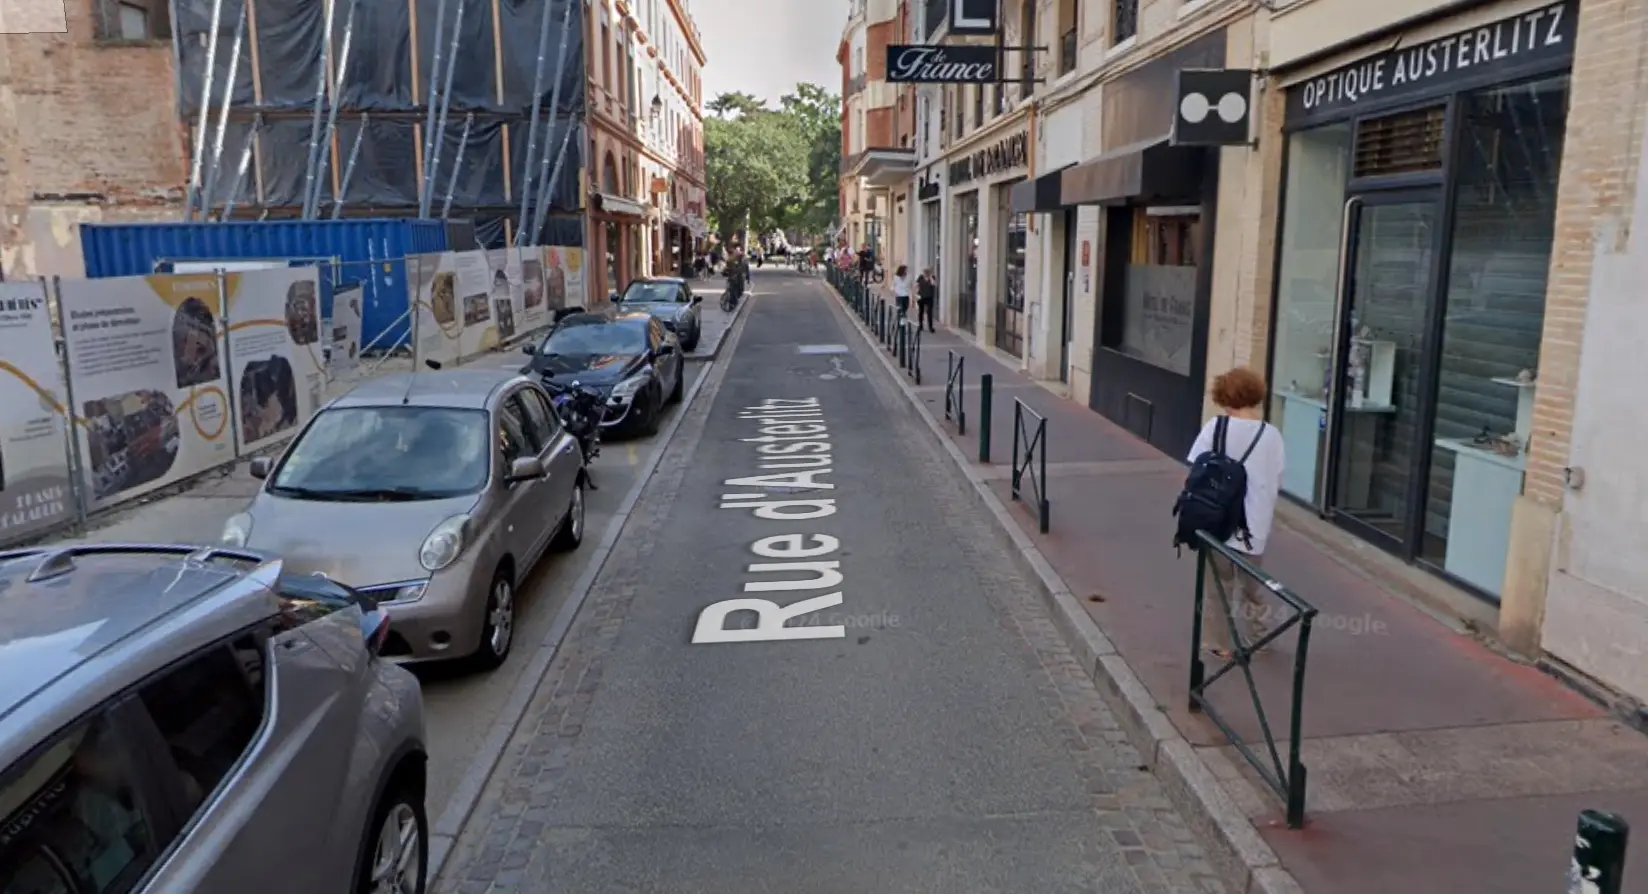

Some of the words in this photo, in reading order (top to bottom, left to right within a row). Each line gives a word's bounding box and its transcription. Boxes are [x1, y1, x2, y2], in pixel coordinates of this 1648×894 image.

[890, 48, 993, 81] France
[930, 49, 946, 63] de
[1303, 61, 1384, 109] OPTIQUE
[1392, 6, 1565, 86] AUSTERLITZ
